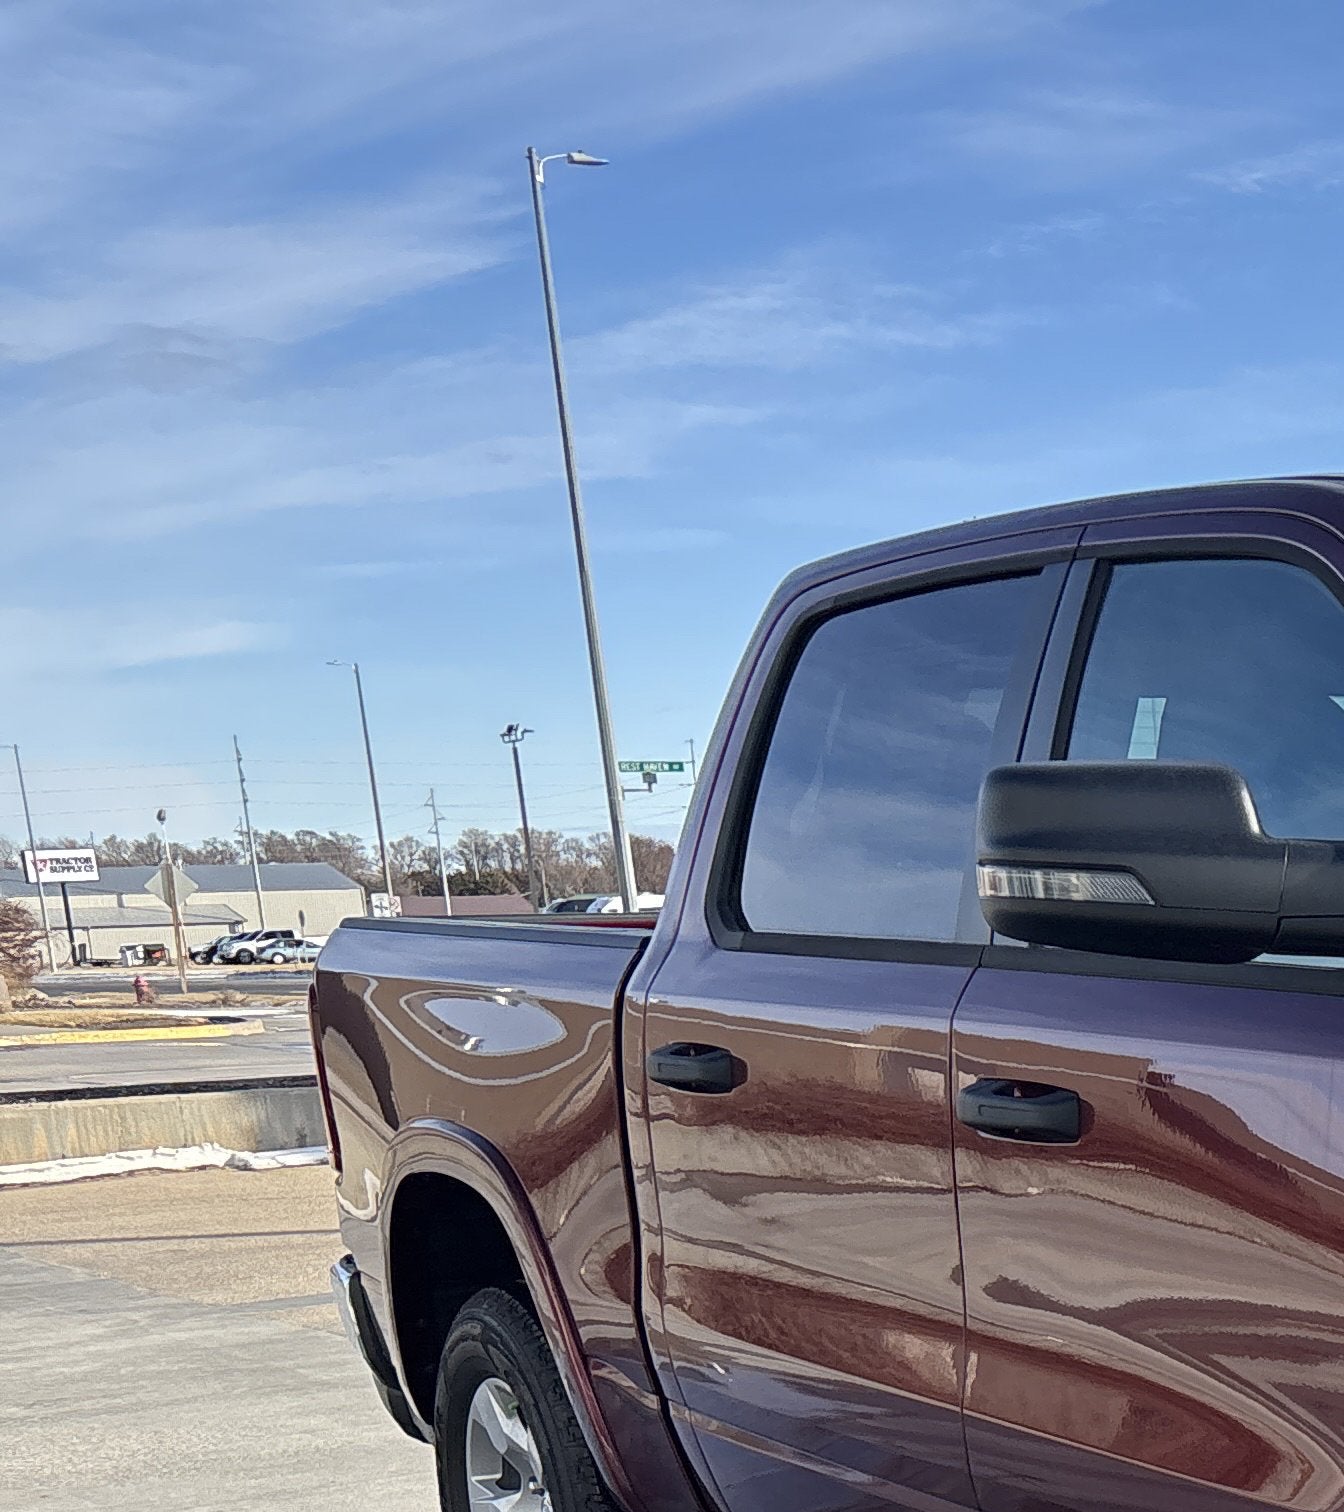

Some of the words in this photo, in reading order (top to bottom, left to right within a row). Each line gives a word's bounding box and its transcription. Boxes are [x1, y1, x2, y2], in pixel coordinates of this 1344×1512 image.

[620, 762, 640, 772] REST
[49, 857, 92, 865] TRACTOR
[49, 865, 82, 873] SUPPLY
